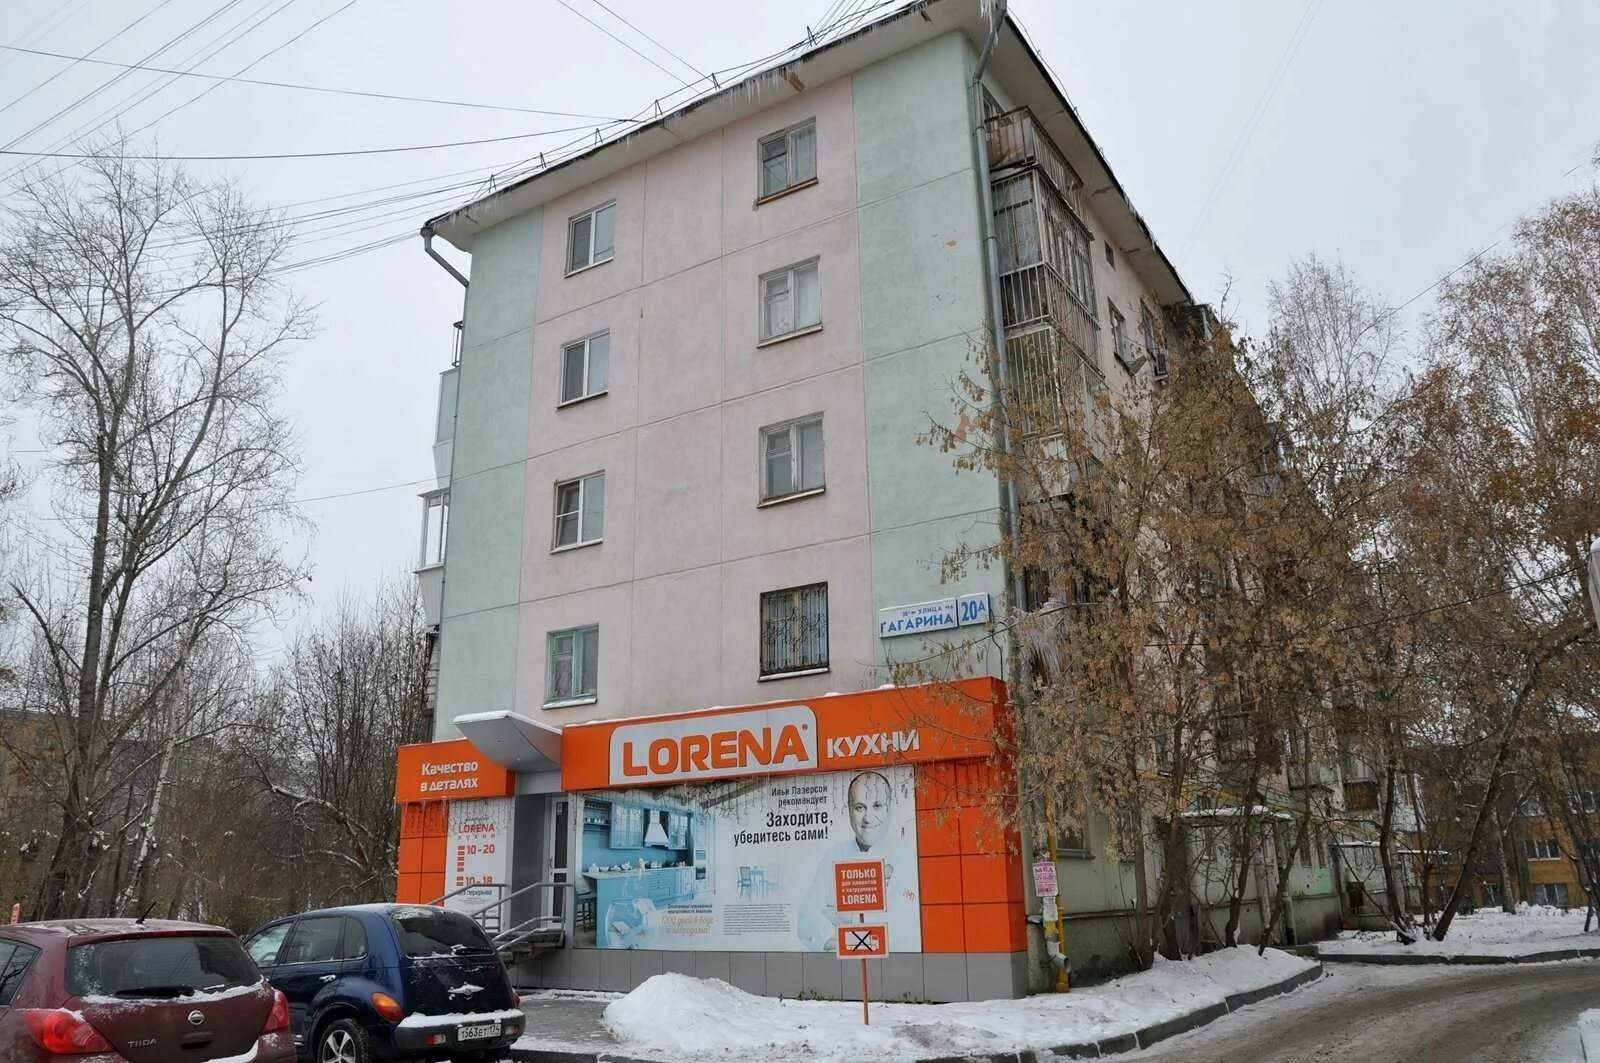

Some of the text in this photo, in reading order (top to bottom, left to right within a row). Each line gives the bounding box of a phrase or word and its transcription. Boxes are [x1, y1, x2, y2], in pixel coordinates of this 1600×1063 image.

[880, 613, 954, 633] ГАГАРИНА
[622, 723, 810, 777] LORENA
[421, 761, 479, 776] Качество
[420, 778, 479, 792] в деталях
[771, 784, 828, 797] Илья Лазерсон
[778, 796, 827, 808] рекомендует
[766, 811, 833, 828] Заходите,
[458, 823, 495, 834] LORENA
[734, 826, 829, 847] убедитесь сами!
[841, 867, 877, 880] ТОЛЬКО
[842, 893, 878, 905] LORENA
[127, 1038, 158, 1048] TIIDA
